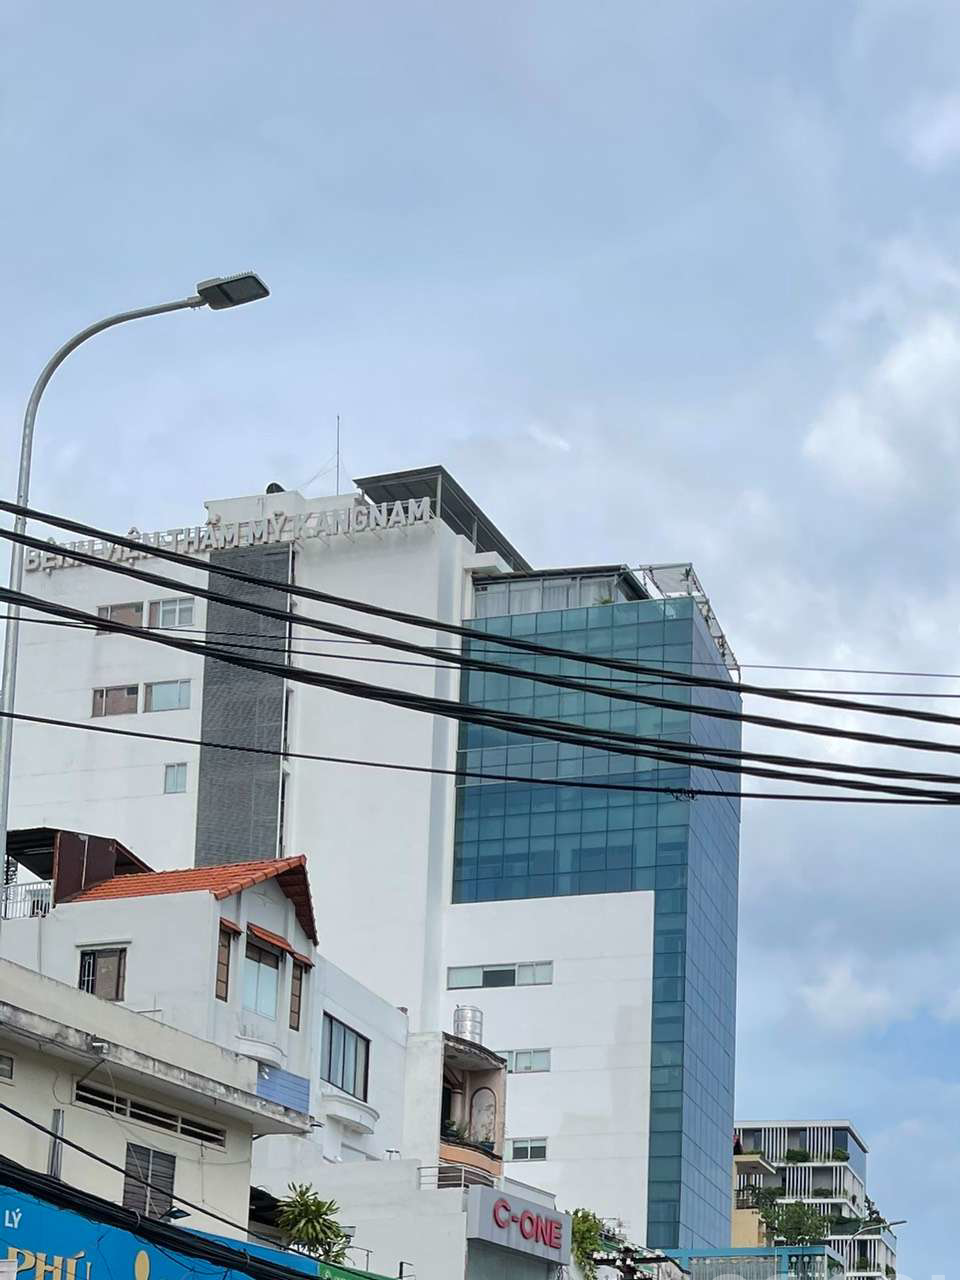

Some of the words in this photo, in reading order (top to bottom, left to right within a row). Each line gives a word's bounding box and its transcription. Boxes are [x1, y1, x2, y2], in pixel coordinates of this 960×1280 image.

[294, 496, 433, 541] KANGNAM
[4, 1208, 22, 1229] LÝ
[494, 1199, 562, 1249] C-ONE
